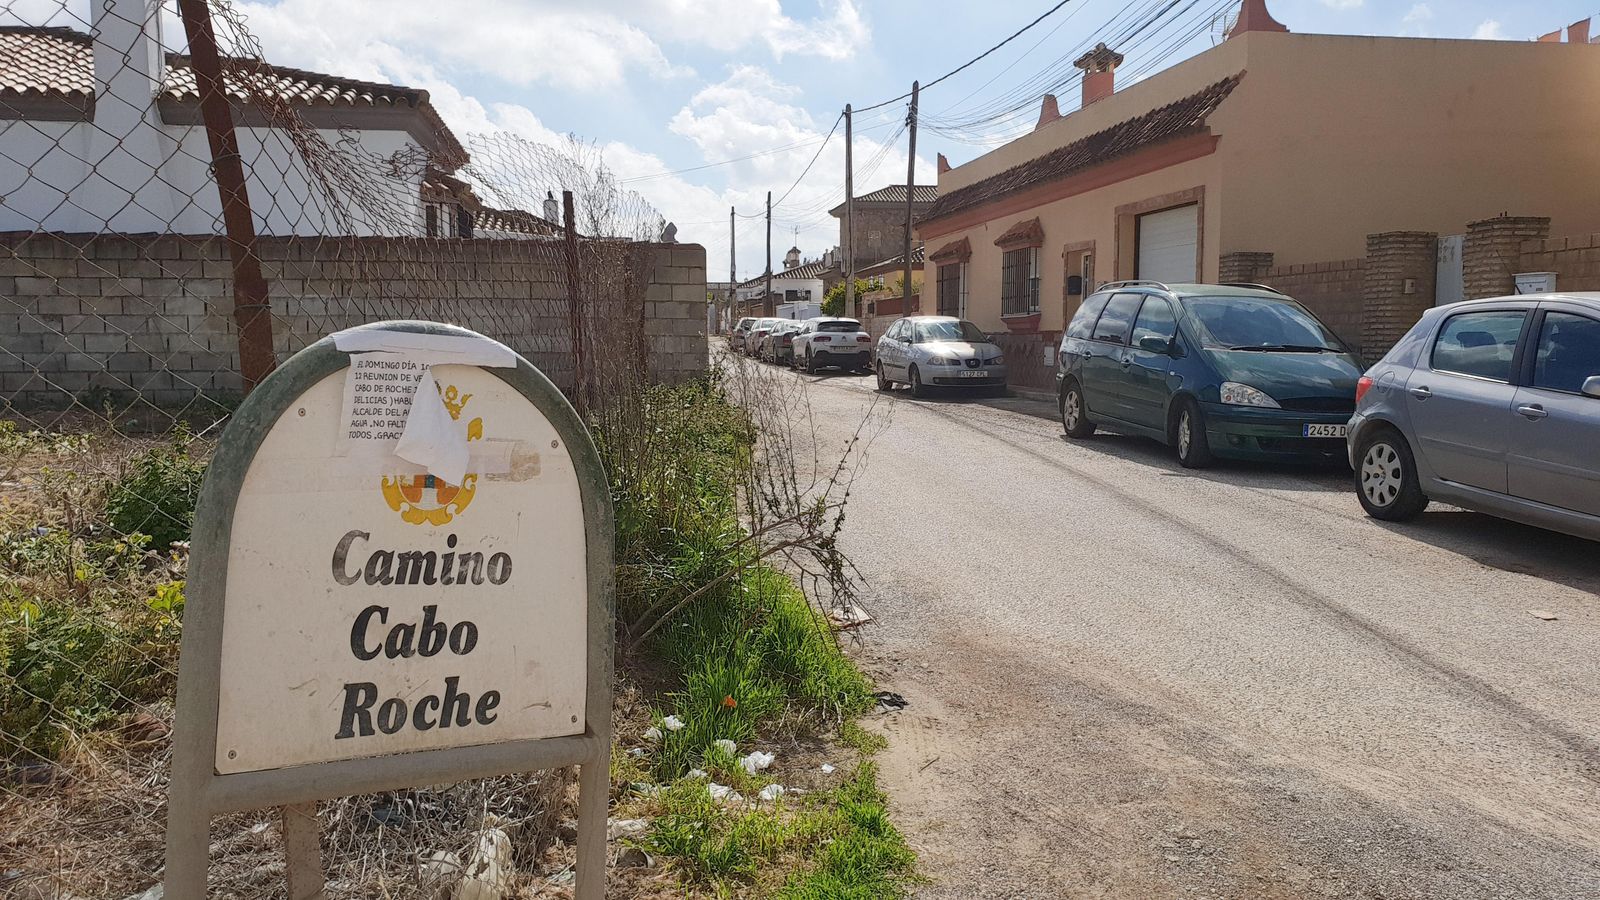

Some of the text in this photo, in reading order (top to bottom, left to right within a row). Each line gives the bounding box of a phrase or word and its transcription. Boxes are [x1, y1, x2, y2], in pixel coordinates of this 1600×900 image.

[364, 360, 400, 370] DOMINGO
[401, 359, 417, 370] DÍA
[363, 372, 398, 381] REUNION
[400, 373, 412, 382] DE
[354, 384, 372, 392] CABO
[373, 384, 384, 393] DE
[385, 385, 413, 394] ROCHE
[353, 395, 388, 405] DELICIAS
[352, 407, 383, 416] ALCALDE
[385, 408, 401, 417] DEL
[350, 419, 368, 428] AGUA
[348, 431, 372, 440] TODOS
[1310, 425, 1337, 436] 2452
[331, 529, 513, 586] Camino
[350, 604, 479, 661] Cabo
[334, 675, 501, 740] Roche
